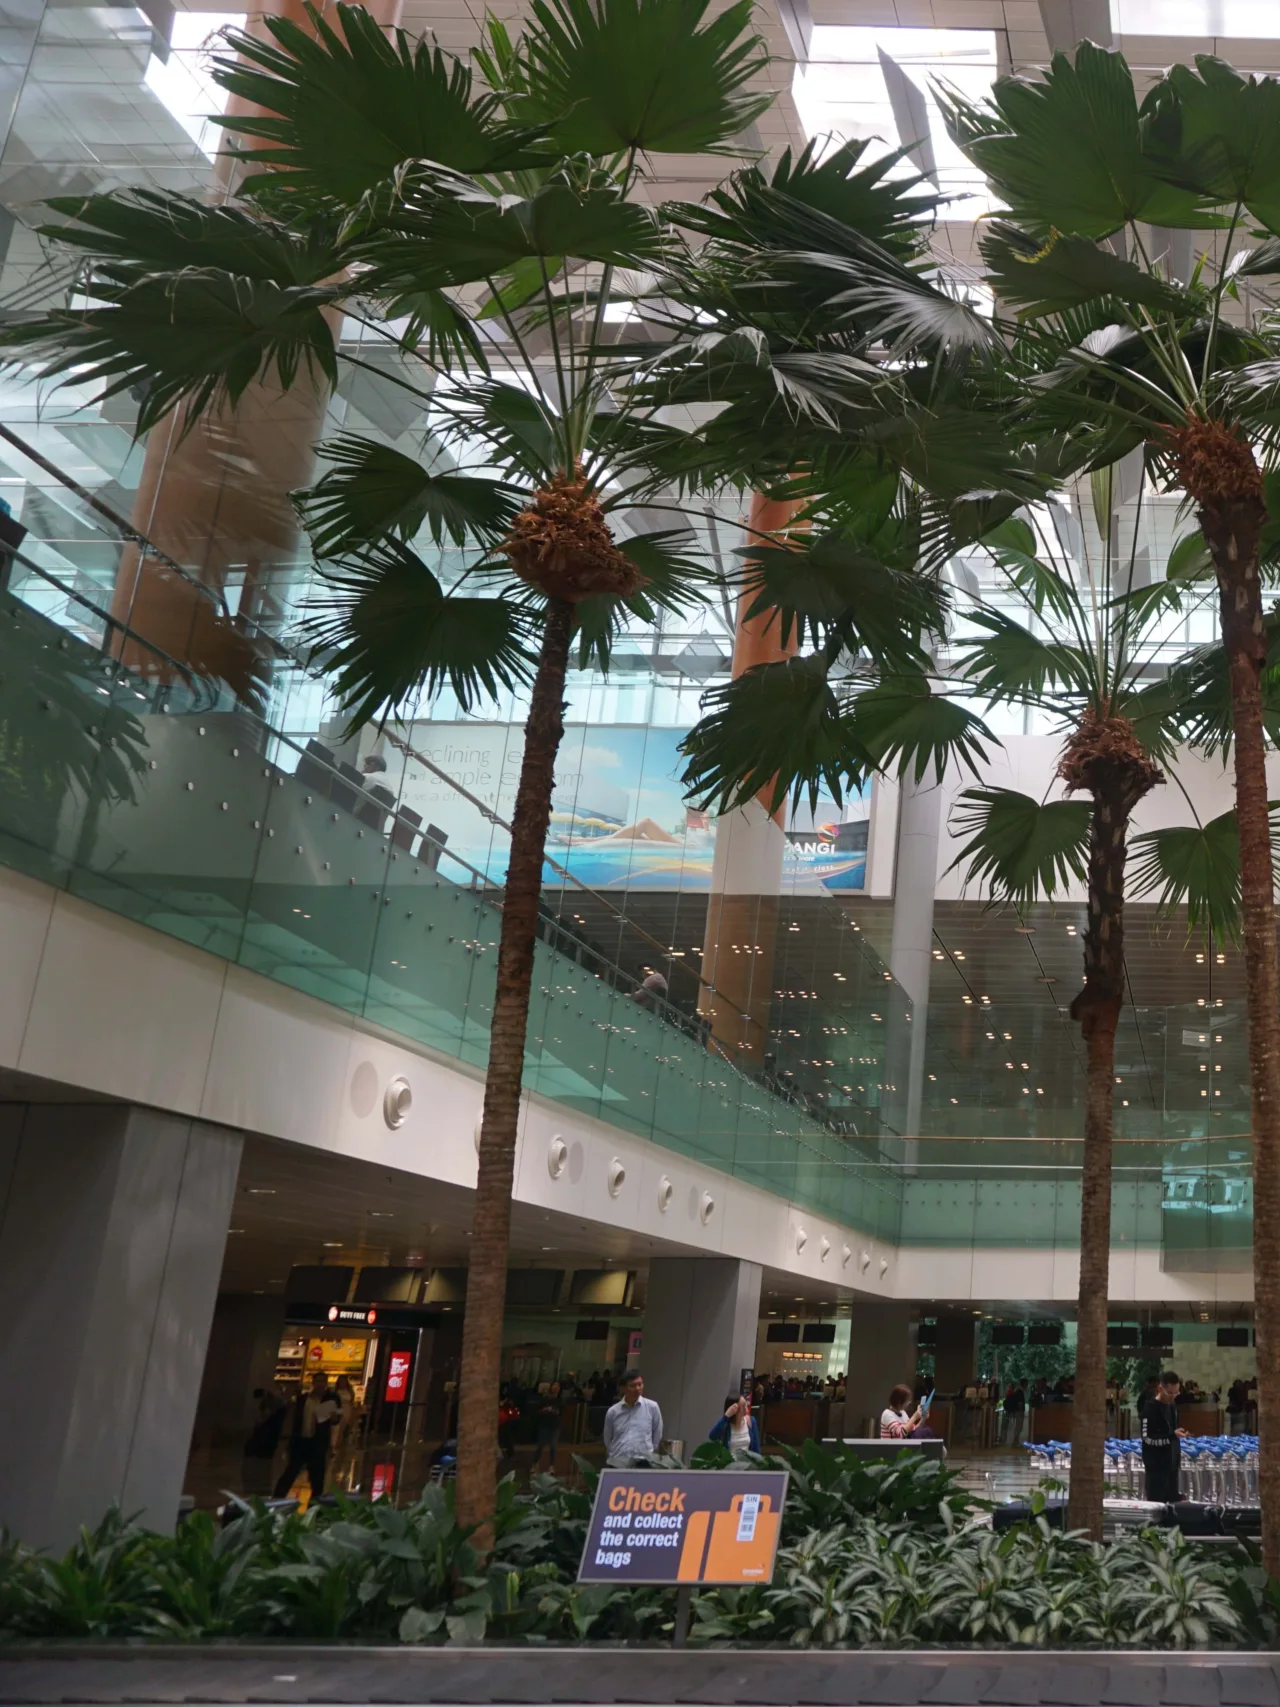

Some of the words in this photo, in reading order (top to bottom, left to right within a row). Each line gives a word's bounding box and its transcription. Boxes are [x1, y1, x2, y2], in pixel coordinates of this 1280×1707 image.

[410, 745, 491, 768] eclining
[608, 1486, 687, 1512] Check
[603, 1513, 632, 1528] and
[634, 1513, 683, 1529] collect
[600, 1530, 623, 1546] the
[626, 1531, 679, 1547] correct
[595, 1548, 631, 1568] bags
